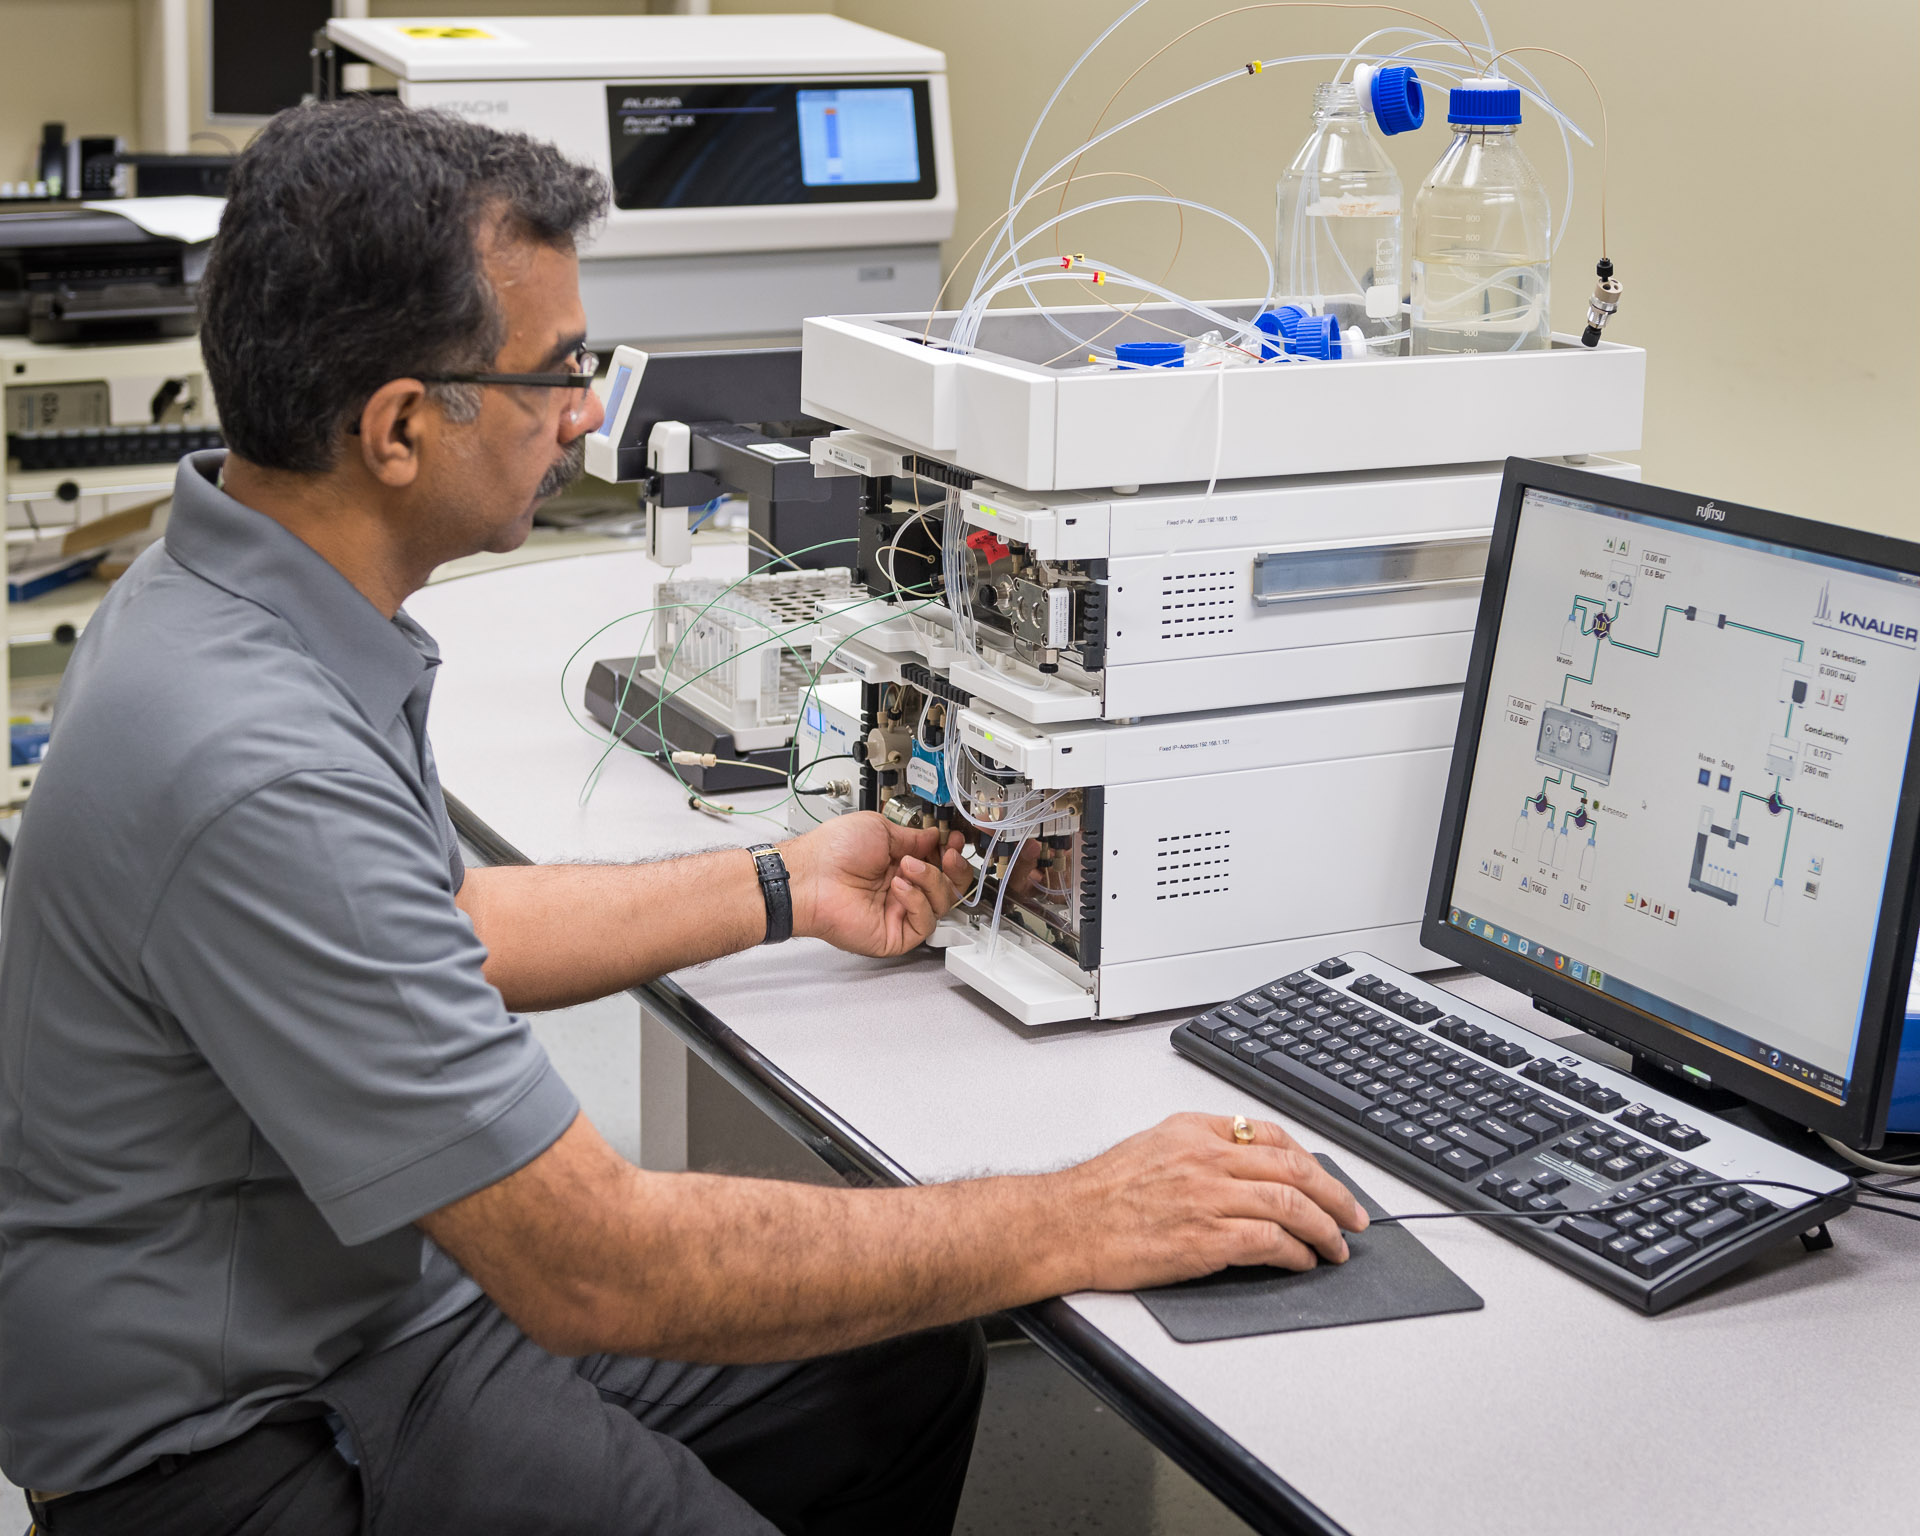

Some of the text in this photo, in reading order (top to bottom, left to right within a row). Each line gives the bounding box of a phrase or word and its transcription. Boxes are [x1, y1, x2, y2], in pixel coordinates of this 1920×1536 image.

[1463, 329, 1478, 337] 300
[1696, 502, 1726, 521] FUJITSU
[1619, 541, 1626, 552] A
[1645, 552, 1667, 565] 0.00 ml
[1579, 568, 1604, 581] Injection
[1654, 569, 1666, 580] Bar
[1839, 610, 1918, 642] KNAUER
[1556, 655, 1574, 666] Waste
[1820, 647, 1867, 667] UV Detection
[1512, 699, 1532, 712] 0.00 ml
[1833, 694, 1845, 706] AZ
[1590, 700, 1631, 720] System Pump
[1509, 713, 1529, 726] 0.0 Bar
[1803, 723, 1849, 745] Conductivity
[1698, 752, 1716, 765] Home
[1818, 768, 1830, 780] nm
[1797, 807, 1845, 831] Fractionation
[1520, 877, 1528, 888] A
[1531, 883, 1547, 896] 100.0
[1562, 893, 1570, 905] B
[1576, 902, 1586, 912] 0.0
